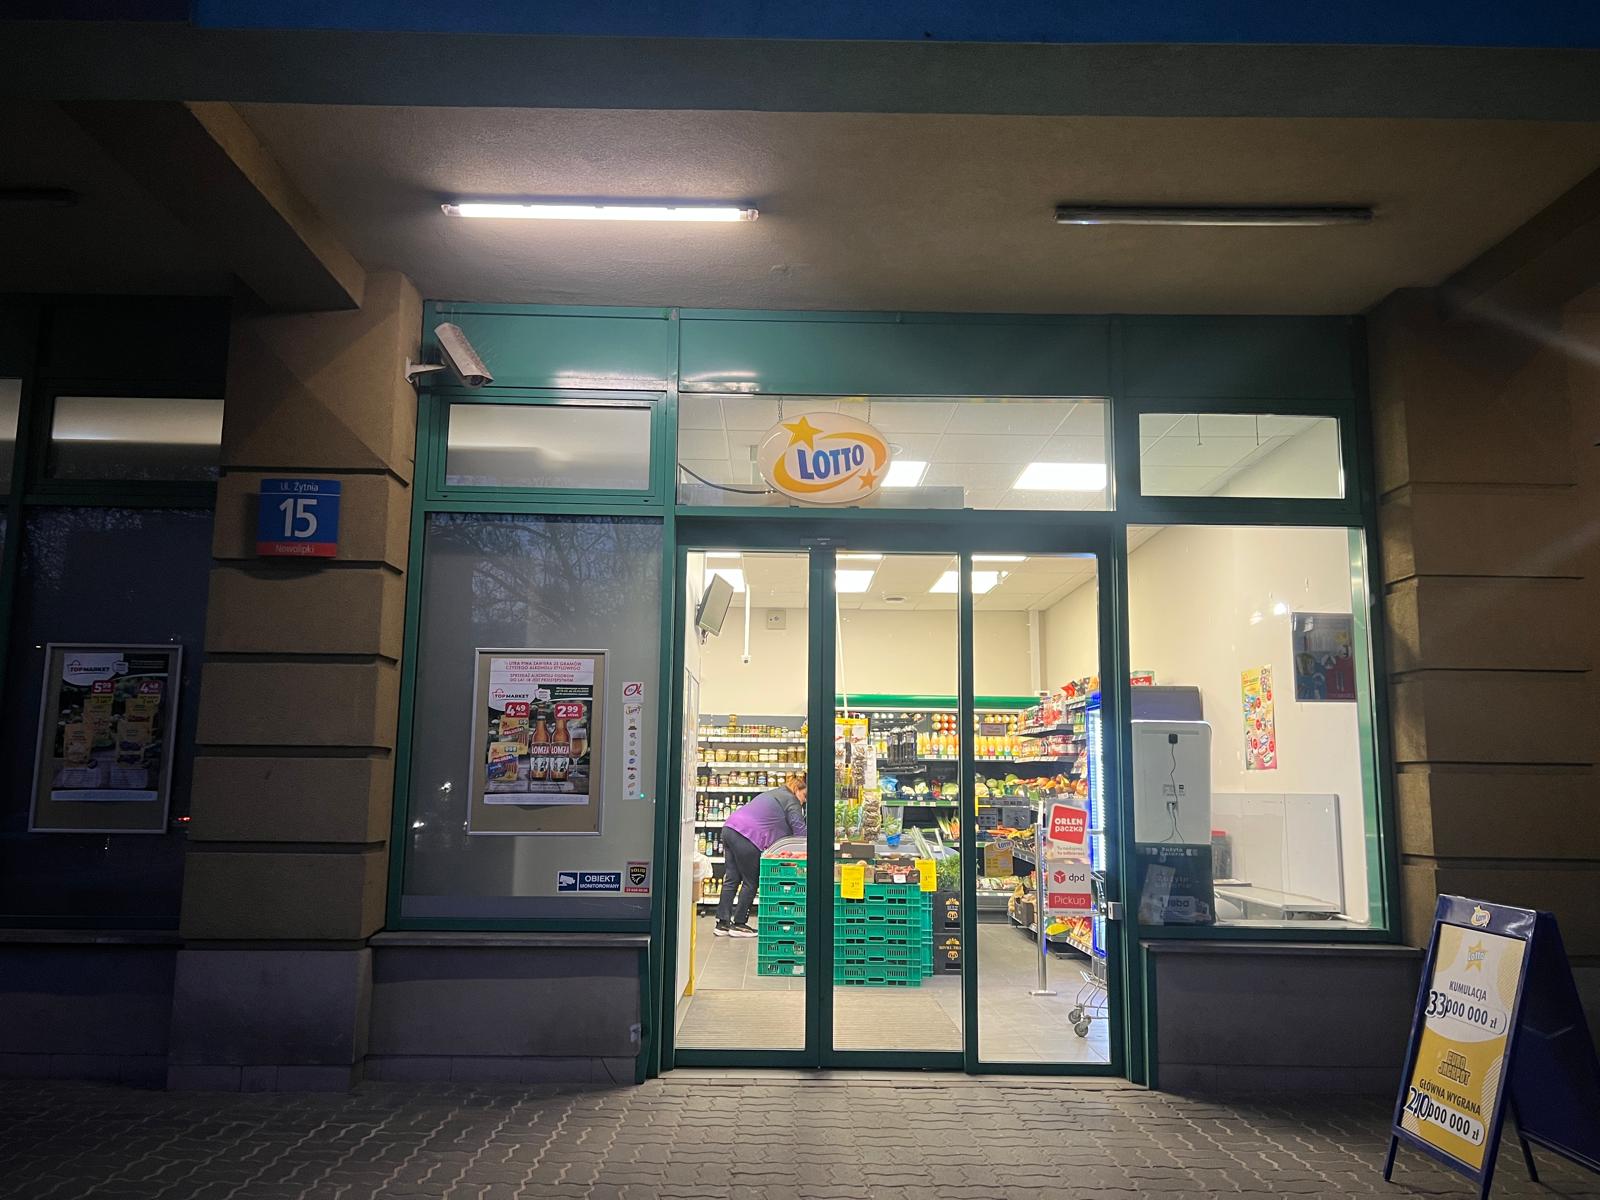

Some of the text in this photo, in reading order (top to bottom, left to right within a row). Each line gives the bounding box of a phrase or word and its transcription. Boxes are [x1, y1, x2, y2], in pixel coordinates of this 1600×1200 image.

[797, 444, 865, 480] LOTTO
[279, 498, 318, 538] 15
[1055, 825, 1083, 833] paczka
[1069, 873, 1085, 883] dpd
[1054, 895, 1086, 906] Pickup
[1449, 980, 1487, 1002] KUMULACJA
[1467, 1006, 1488, 1025] 000
[1438, 1061, 1471, 1086] JACKPOT
[1447, 1091, 1481, 1116] WYGRANA
[1449, 1114, 1470, 1135] 000
